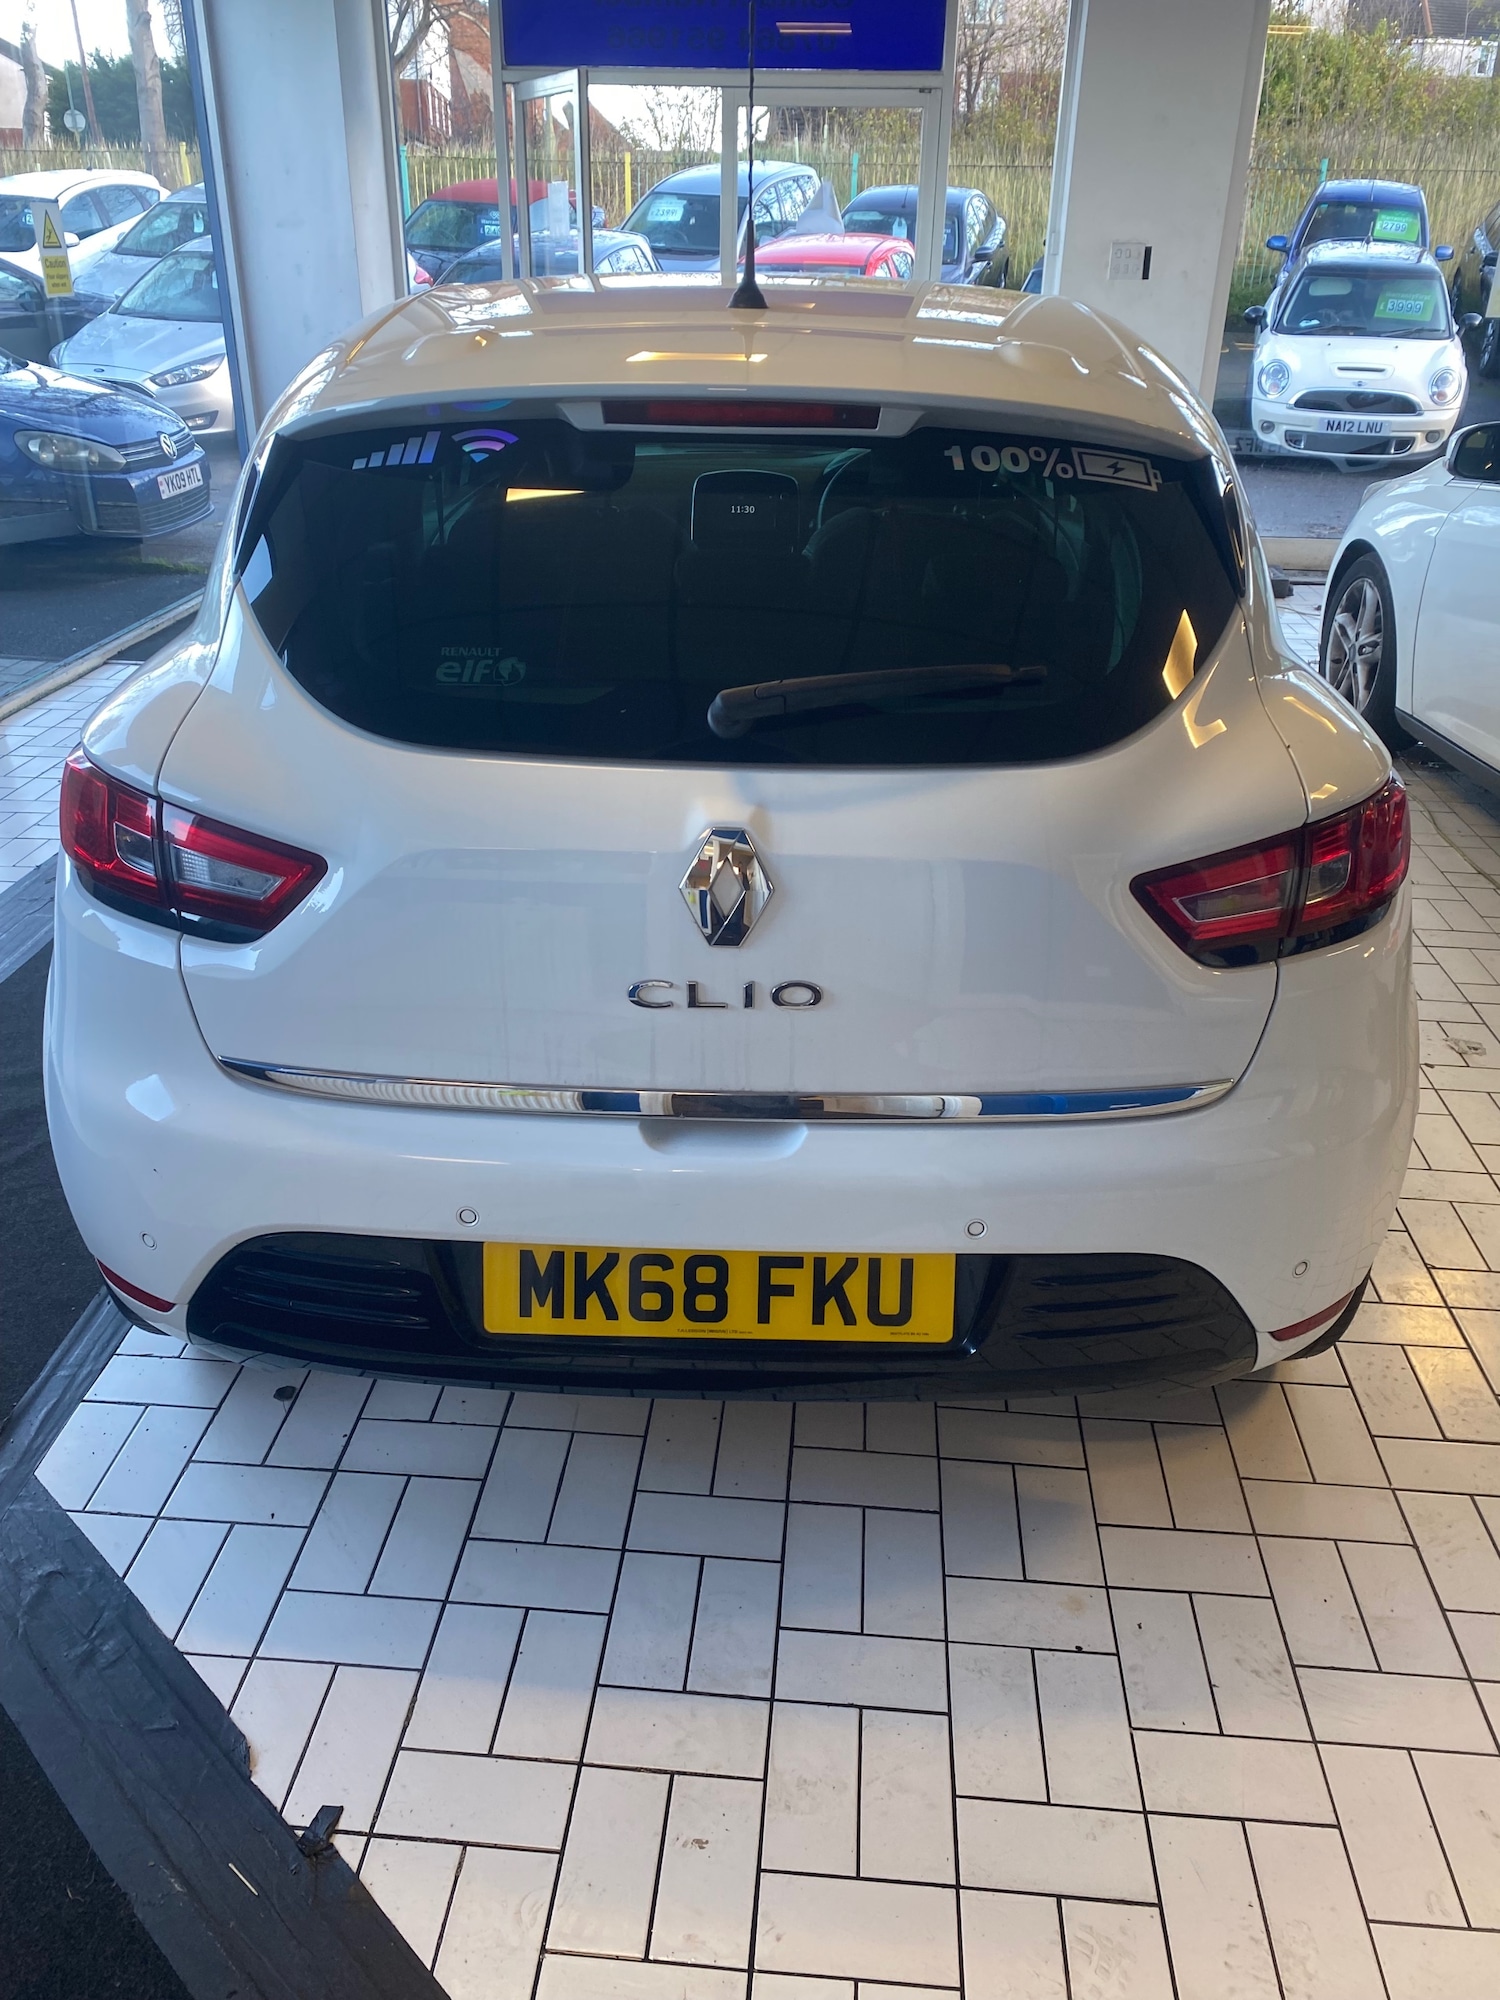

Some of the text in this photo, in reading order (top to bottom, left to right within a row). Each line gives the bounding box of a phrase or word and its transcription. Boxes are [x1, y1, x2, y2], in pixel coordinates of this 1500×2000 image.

[1326, 420, 1384, 433] NA12 LNU
[944, 445, 1074, 479] 100%
[164, 467, 201, 493] YK09 HTL
[731, 505, 755, 514] 11:30
[441, 646, 502, 656] RENAULT
[628, 979, 824, 1010] CLIO
[519, 1249, 914, 1327] MK68 FKU
